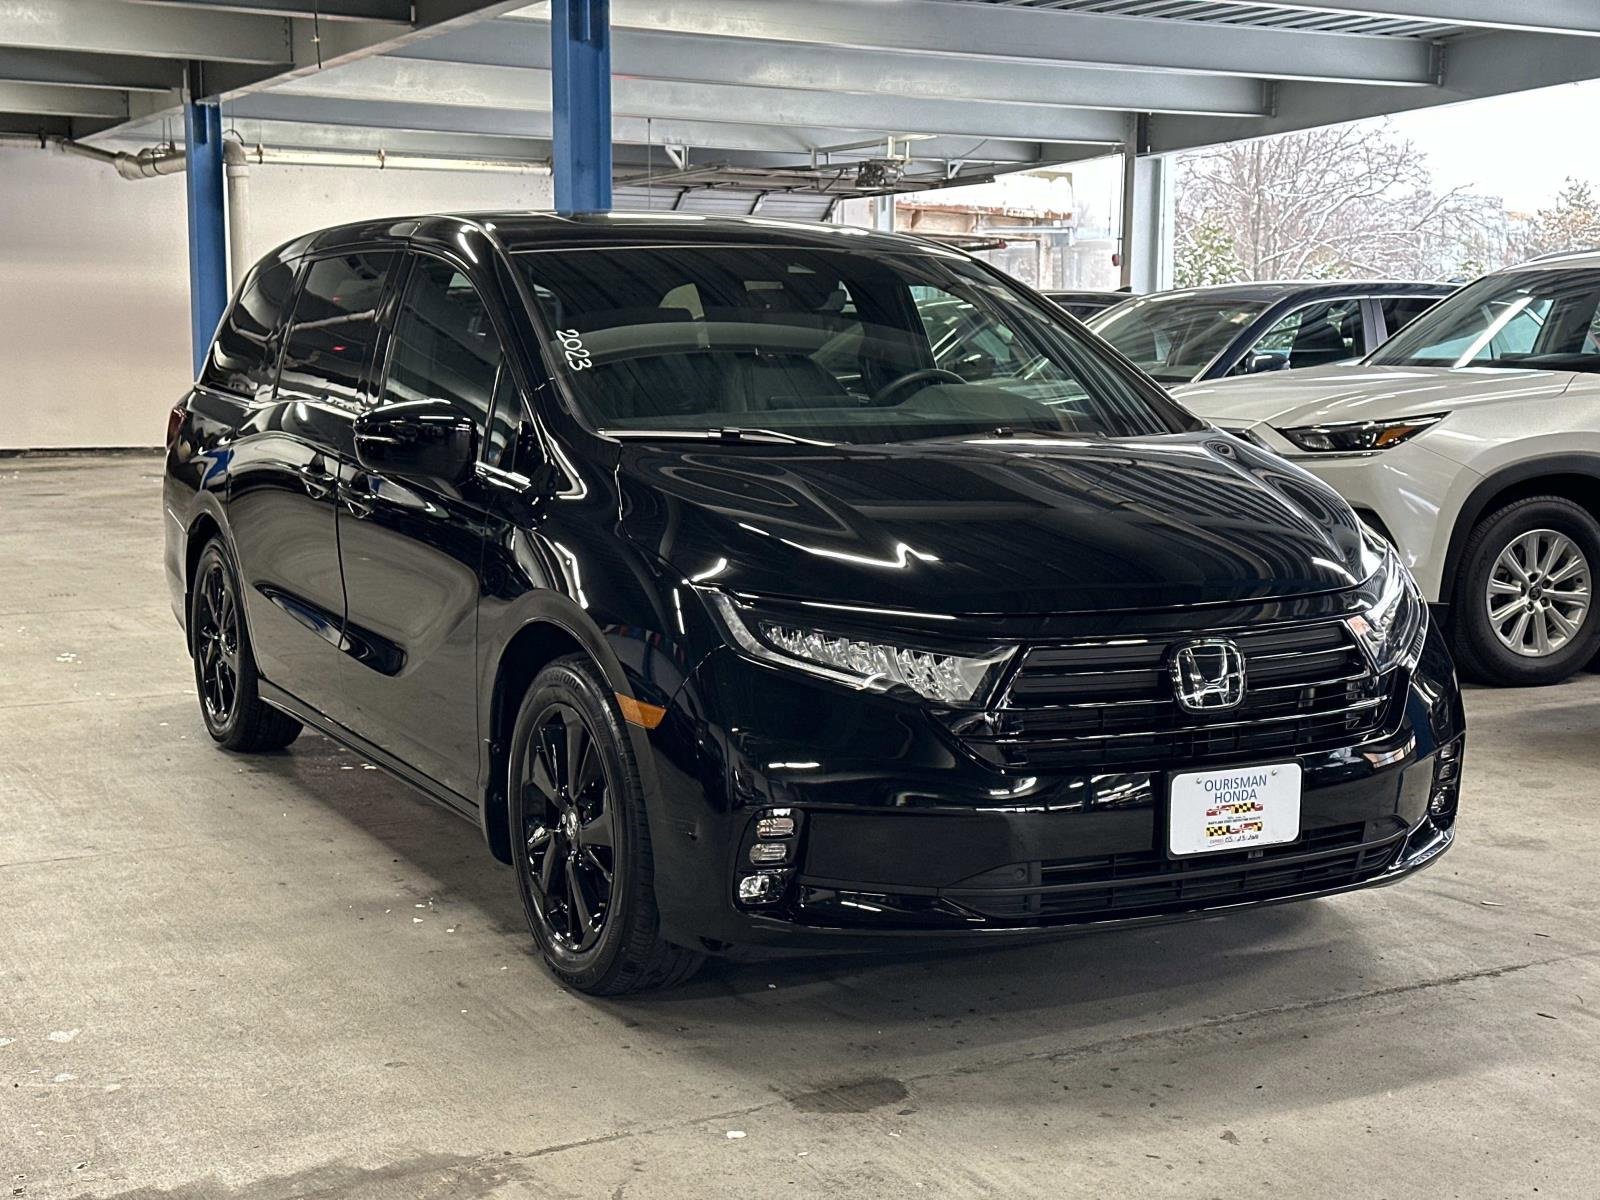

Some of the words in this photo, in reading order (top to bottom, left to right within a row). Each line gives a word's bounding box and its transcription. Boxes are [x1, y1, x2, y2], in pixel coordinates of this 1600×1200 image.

[556, 329, 592, 371] 2023
[1204, 775, 1267, 792] OURISMAN
[1215, 789, 1257, 803] HONDA
